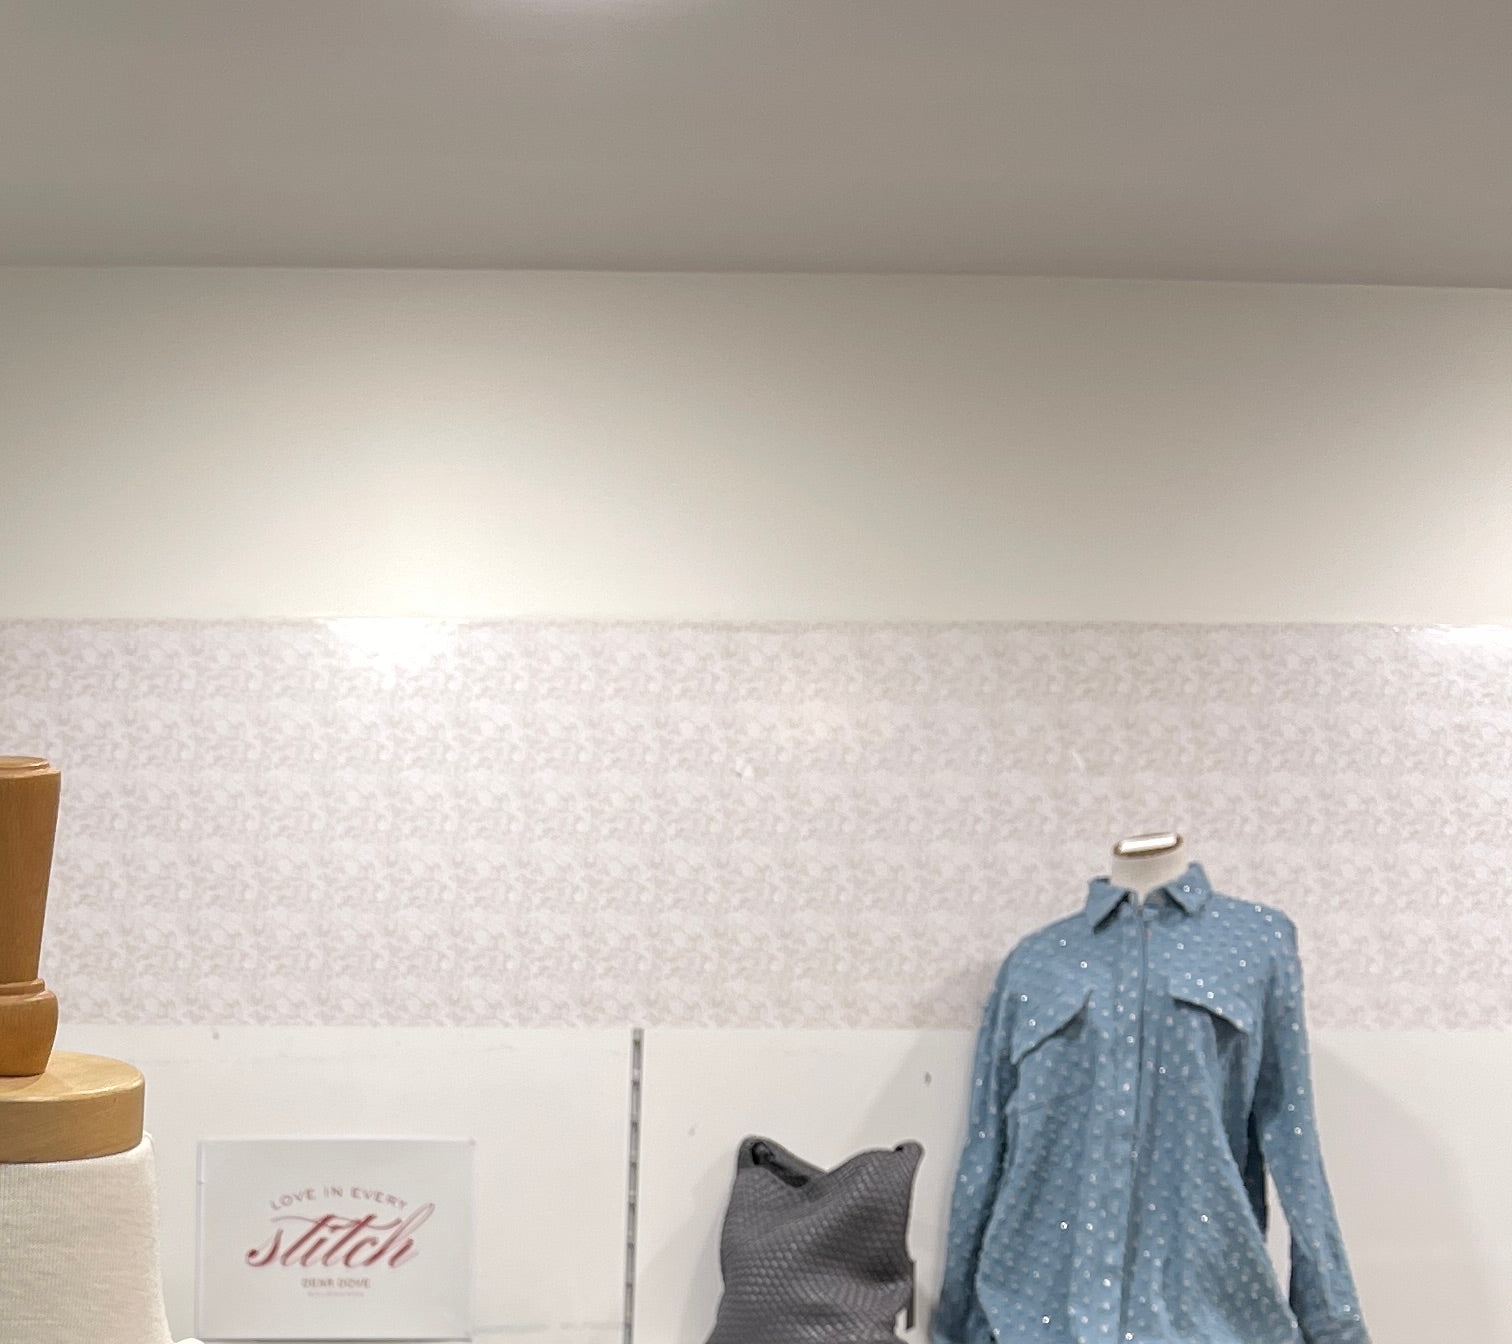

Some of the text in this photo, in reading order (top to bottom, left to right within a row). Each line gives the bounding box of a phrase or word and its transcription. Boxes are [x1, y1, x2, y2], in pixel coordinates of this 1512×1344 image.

[270, 1186, 408, 1210] LOVE IN EVERY
[245, 1202, 436, 1268] stitch
